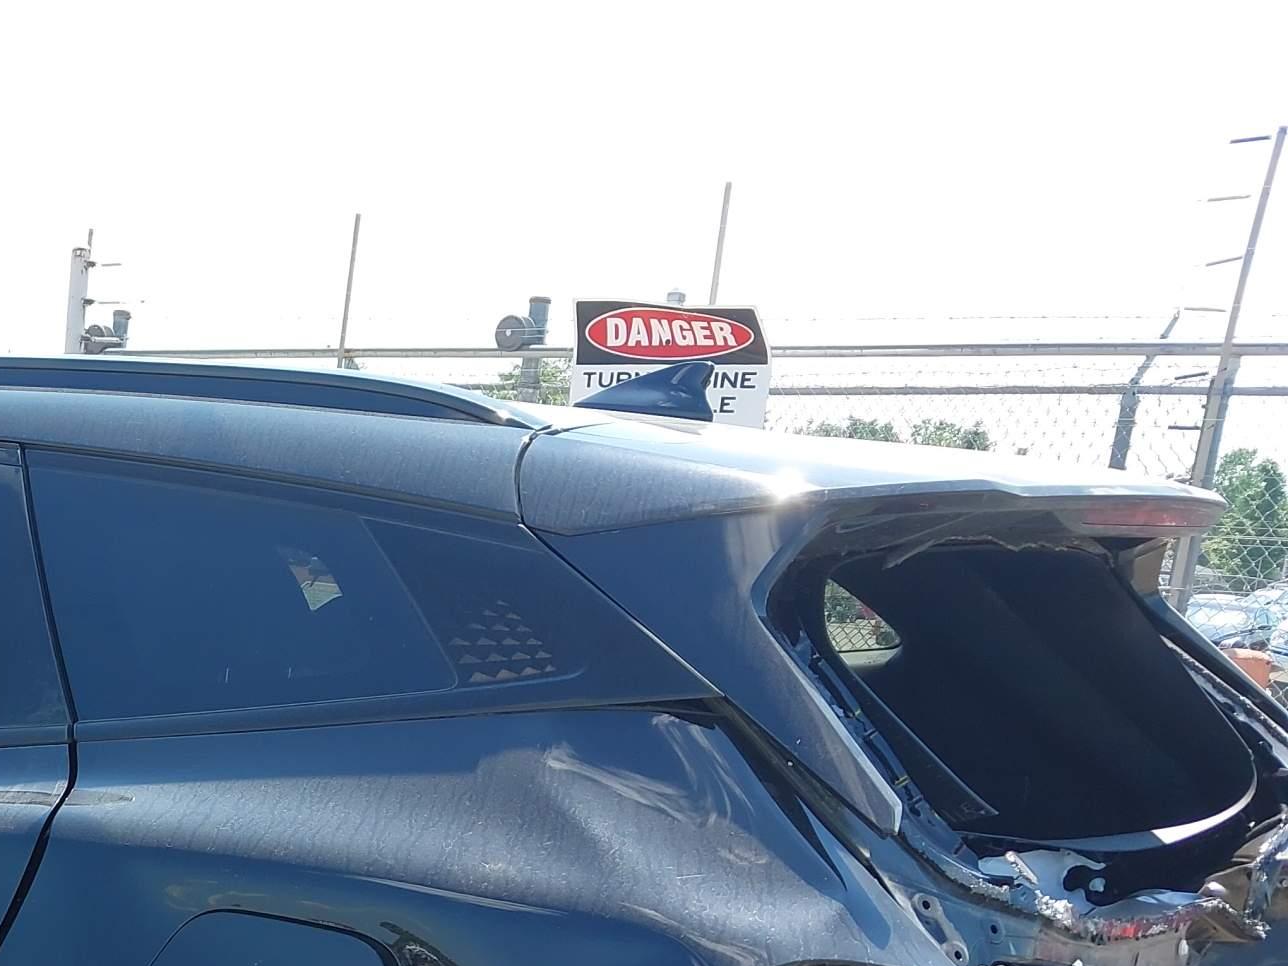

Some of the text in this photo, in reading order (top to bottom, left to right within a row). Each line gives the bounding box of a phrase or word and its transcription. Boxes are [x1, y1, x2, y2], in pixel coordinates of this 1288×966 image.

[605, 316, 739, 347] DANGER
[582, 371, 758, 389] TUR INE
